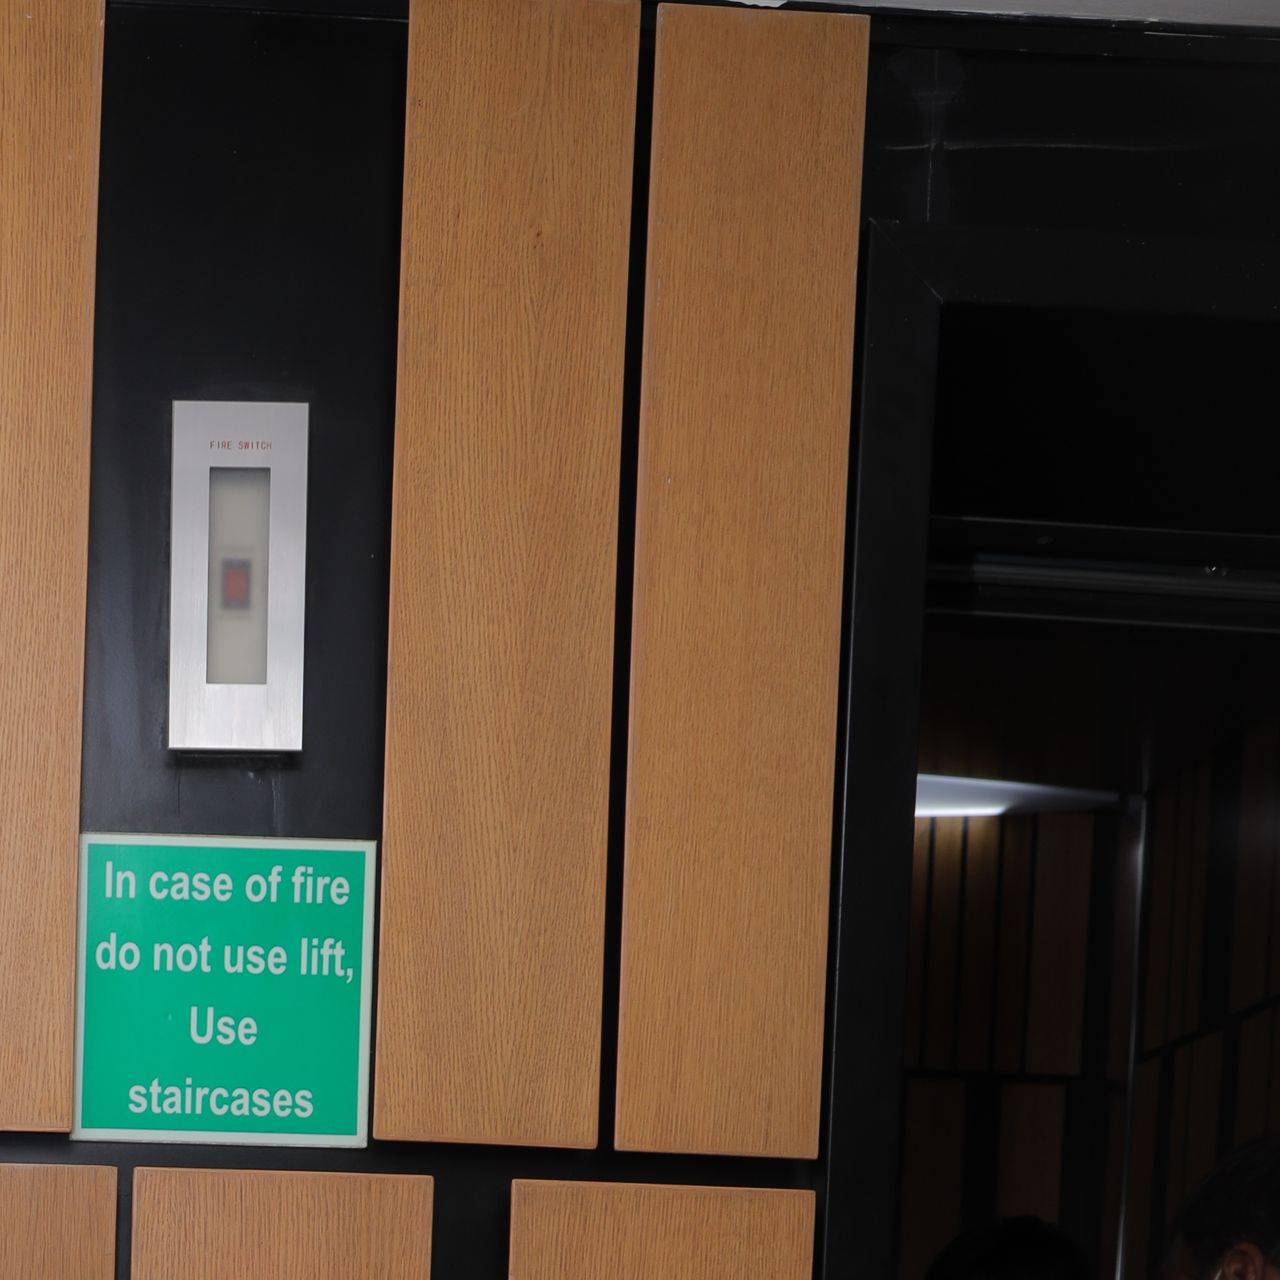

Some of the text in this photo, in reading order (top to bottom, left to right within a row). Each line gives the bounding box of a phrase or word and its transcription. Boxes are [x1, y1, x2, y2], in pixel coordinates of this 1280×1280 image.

[208, 440, 272, 451] FIRE SWITCH
[104, 860, 350, 905] In case of fire
[95, 932, 354, 984] do not use lift,
[189, 1005, 258, 1046] Use
[128, 1077, 314, 1119] staircases
